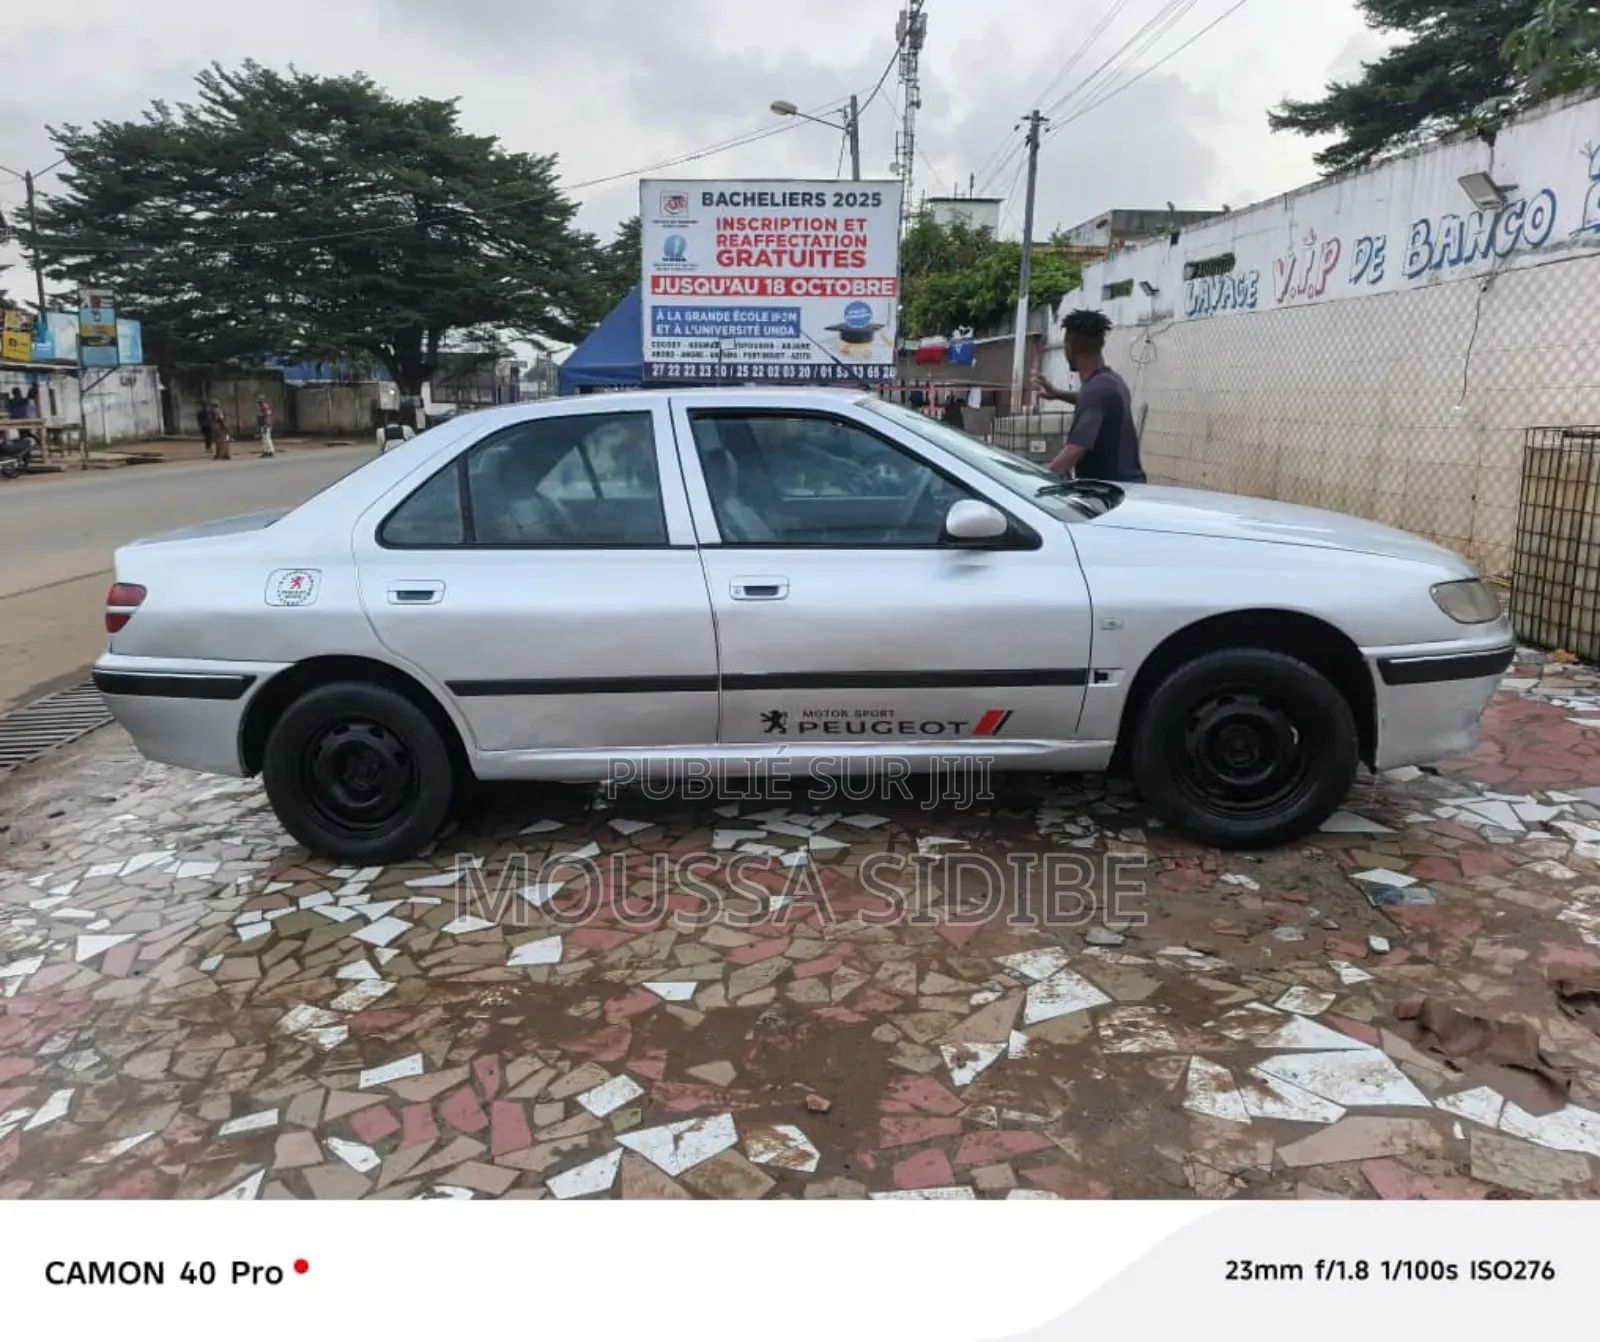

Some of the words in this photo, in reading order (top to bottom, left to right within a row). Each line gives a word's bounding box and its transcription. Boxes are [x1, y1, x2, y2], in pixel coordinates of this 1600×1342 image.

[701, 191, 826, 208] BACHELIERS
[832, 191, 882, 208] 2025
[716, 217, 838, 232] INSCRIPTION
[844, 218, 868, 232] ET
[716, 234, 868, 249] REAFFECTATION
[716, 249, 866, 268] GRATUITES
[1183, 271, 1261, 316] LAVAGE
[1349, 235, 1387, 285] DE
[1401, 188, 1557, 280] BANCO
[654, 277, 759, 295] JUSQU'AU
[765, 278, 785, 295] 18
[791, 278, 895, 296] OCTOBRE
[667, 311, 682, 322] LA
[684, 311, 731, 322] GRANDE
[733, 308, 769, 322] ÉCOLE
[656, 325, 669, 335] ET
[685, 323, 761, 336] L'UNIVERSITÉ
[802, 710, 849, 719] MOTOR
[854, 709, 896, 718] SPORT
[797, 719, 969, 736] PEUGEOT
